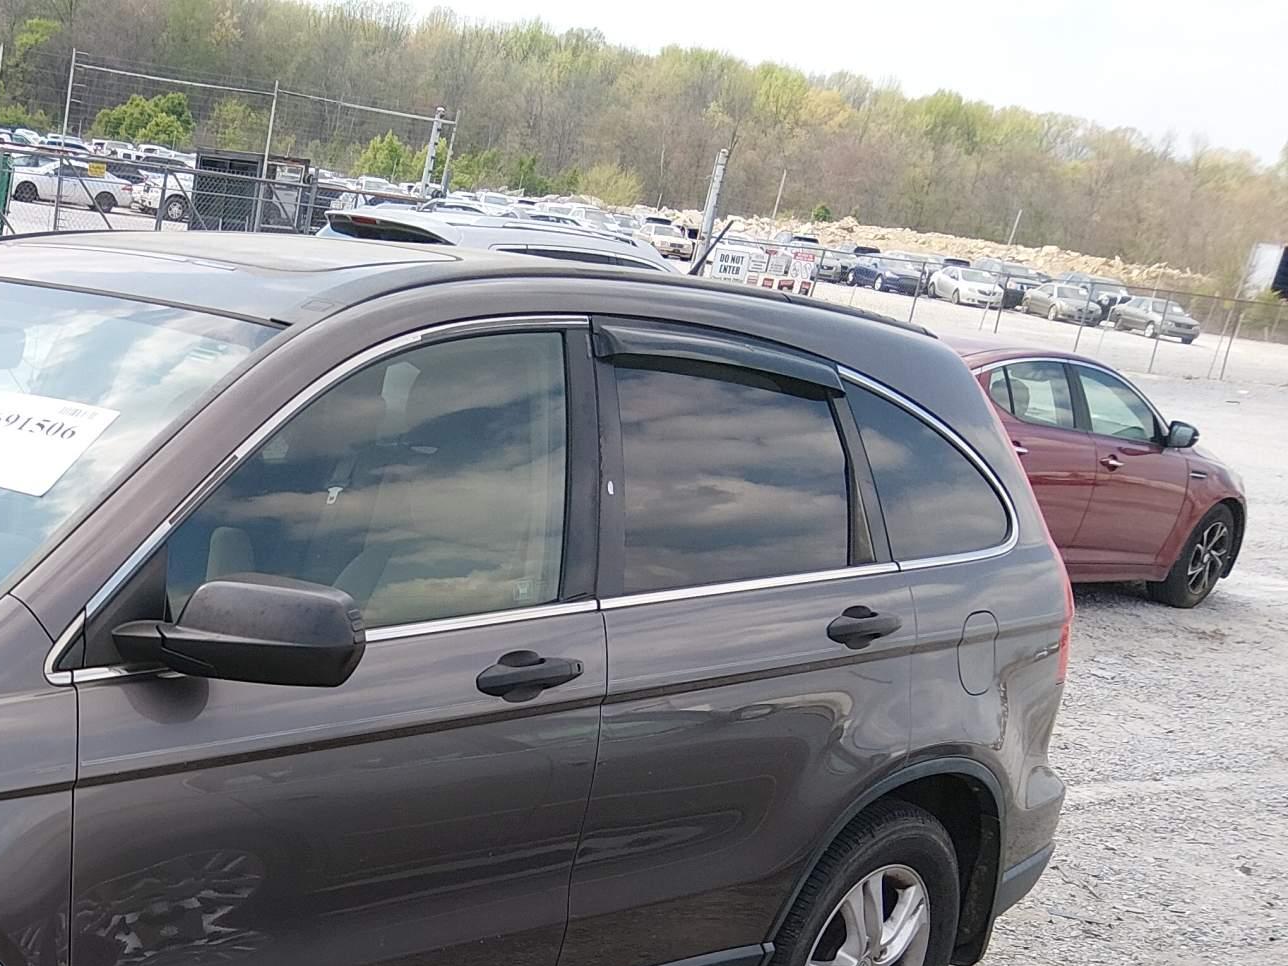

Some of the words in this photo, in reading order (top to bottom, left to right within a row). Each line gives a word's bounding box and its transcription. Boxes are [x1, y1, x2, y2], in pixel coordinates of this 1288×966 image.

[720, 253, 730, 263] DO
[731, 255, 744, 265] NOT
[718, 264, 741, 275] ENTER
